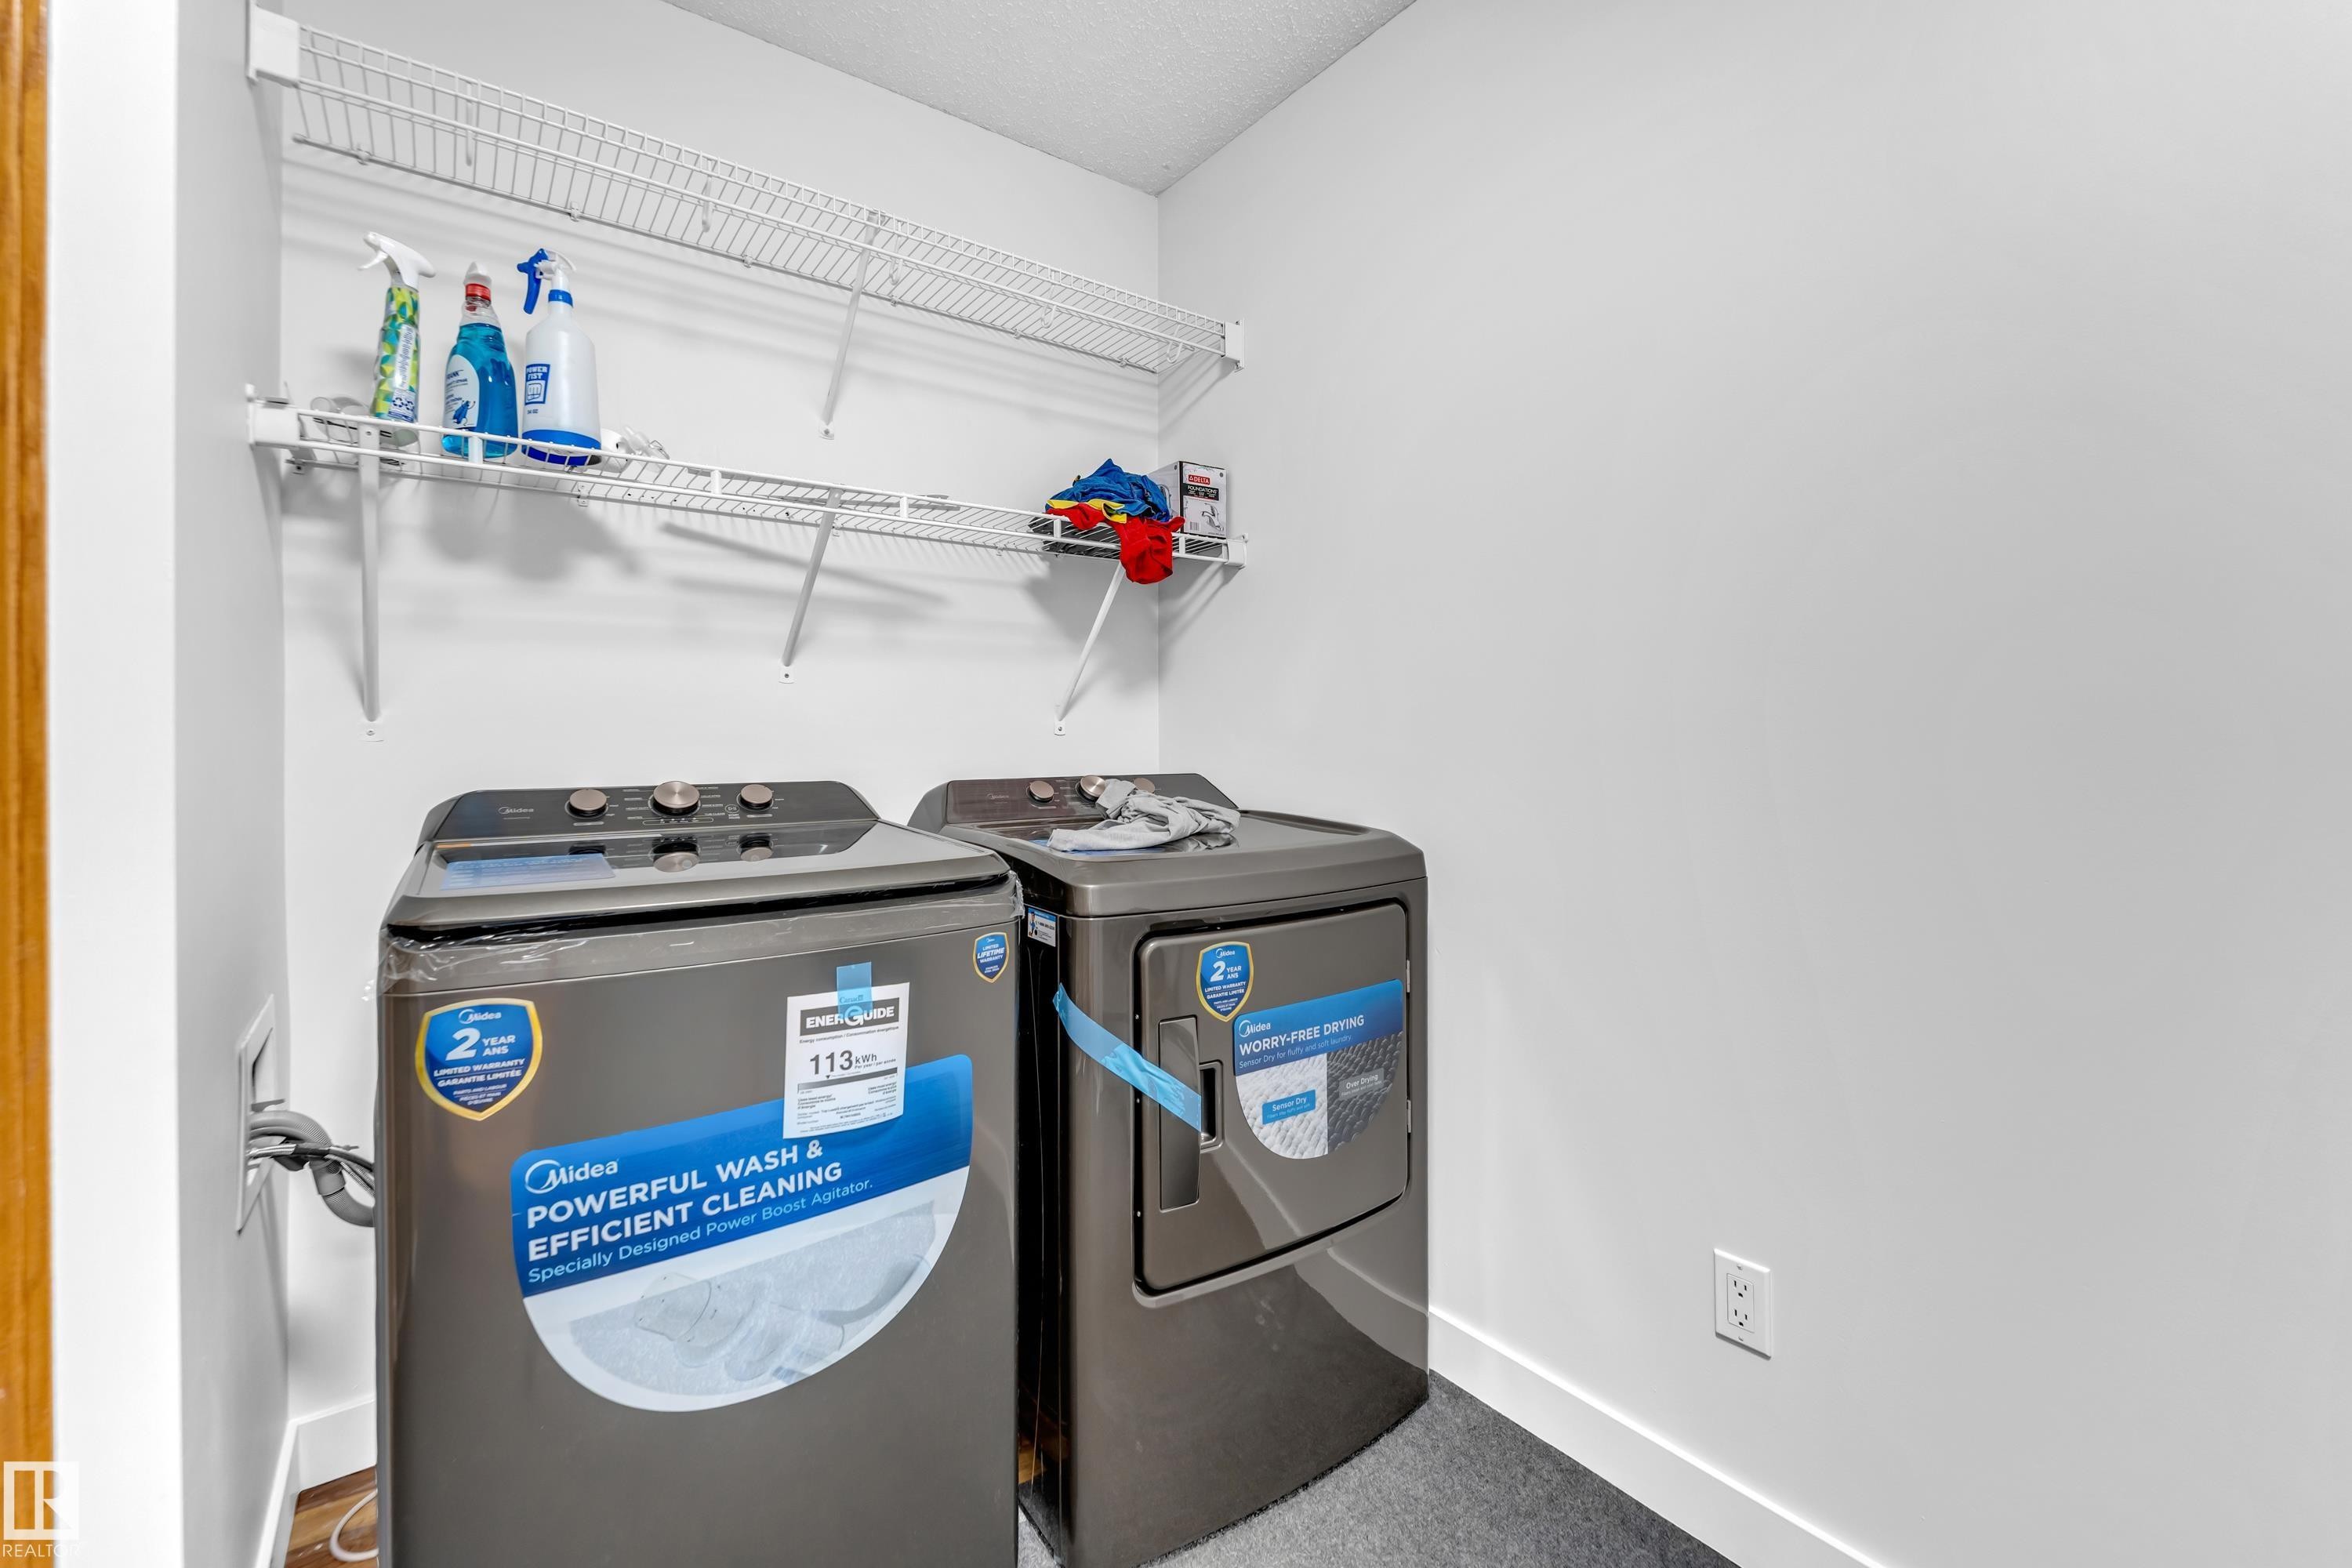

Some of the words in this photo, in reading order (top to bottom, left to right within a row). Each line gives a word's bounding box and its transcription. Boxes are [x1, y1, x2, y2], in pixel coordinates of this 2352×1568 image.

[1188, 485, 1217, 494] FOUNDATIONS
[978, 947, 1005, 959] LIFETIME
[1215, 949, 1236, 958] Midea
[1210, 960, 1226, 982] 2
[459, 1008, 502, 1024] Midea
[806, 1005, 895, 1029] ENERGUIDE
[1239, 1019, 1272, 1038] Midea
[1240, 1025, 1321, 1056] WORRY-FREE
[1323, 1014, 1365, 1036] DRYING
[445, 1027, 481, 1062] 2
[481, 1035, 516, 1047] YEAR
[482, 1045, 510, 1057] ANS
[1239, 1058, 1262, 1069] Sensor
[1263, 1054, 1276, 1064] Dry
[1287, 1046, 1303, 1057] fluffy
[1305, 1044, 1317, 1052] and
[1317, 1040, 1330, 1049] soft
[434, 1066, 471, 1077] LIMITED
[472, 1058, 526, 1072] WARRANTY
[810, 1050, 854, 1075] 113
[855, 1054, 877, 1065] kWh
[437, 1074, 486, 1087] GARANTIE
[486, 1069, 522, 1080] LIMITÉE
[1345, 1080, 1359, 1090] Over
[1360, 1074, 1378, 1086] Drying
[1272, 1100, 1294, 1112] Sensor
[1295, 1097, 1307, 1105] Dry
[524, 1159, 619, 1195] Midea
[527, 1169, 708, 1229] POWERFUL
[715, 1145, 798, 1183] WASH
[806, 1139, 823, 1160] &
[528, 1201, 694, 1262] EFFICIENT
[702, 1162, 843, 1216] CLEANING
[528, 1251, 613, 1283] Specially
[619, 1226, 701, 1260] Designed
[706, 1213, 757, 1236] Power
[762, 1197, 806, 1221] Boost
[811, 1179, 873, 1207] Agitator.
